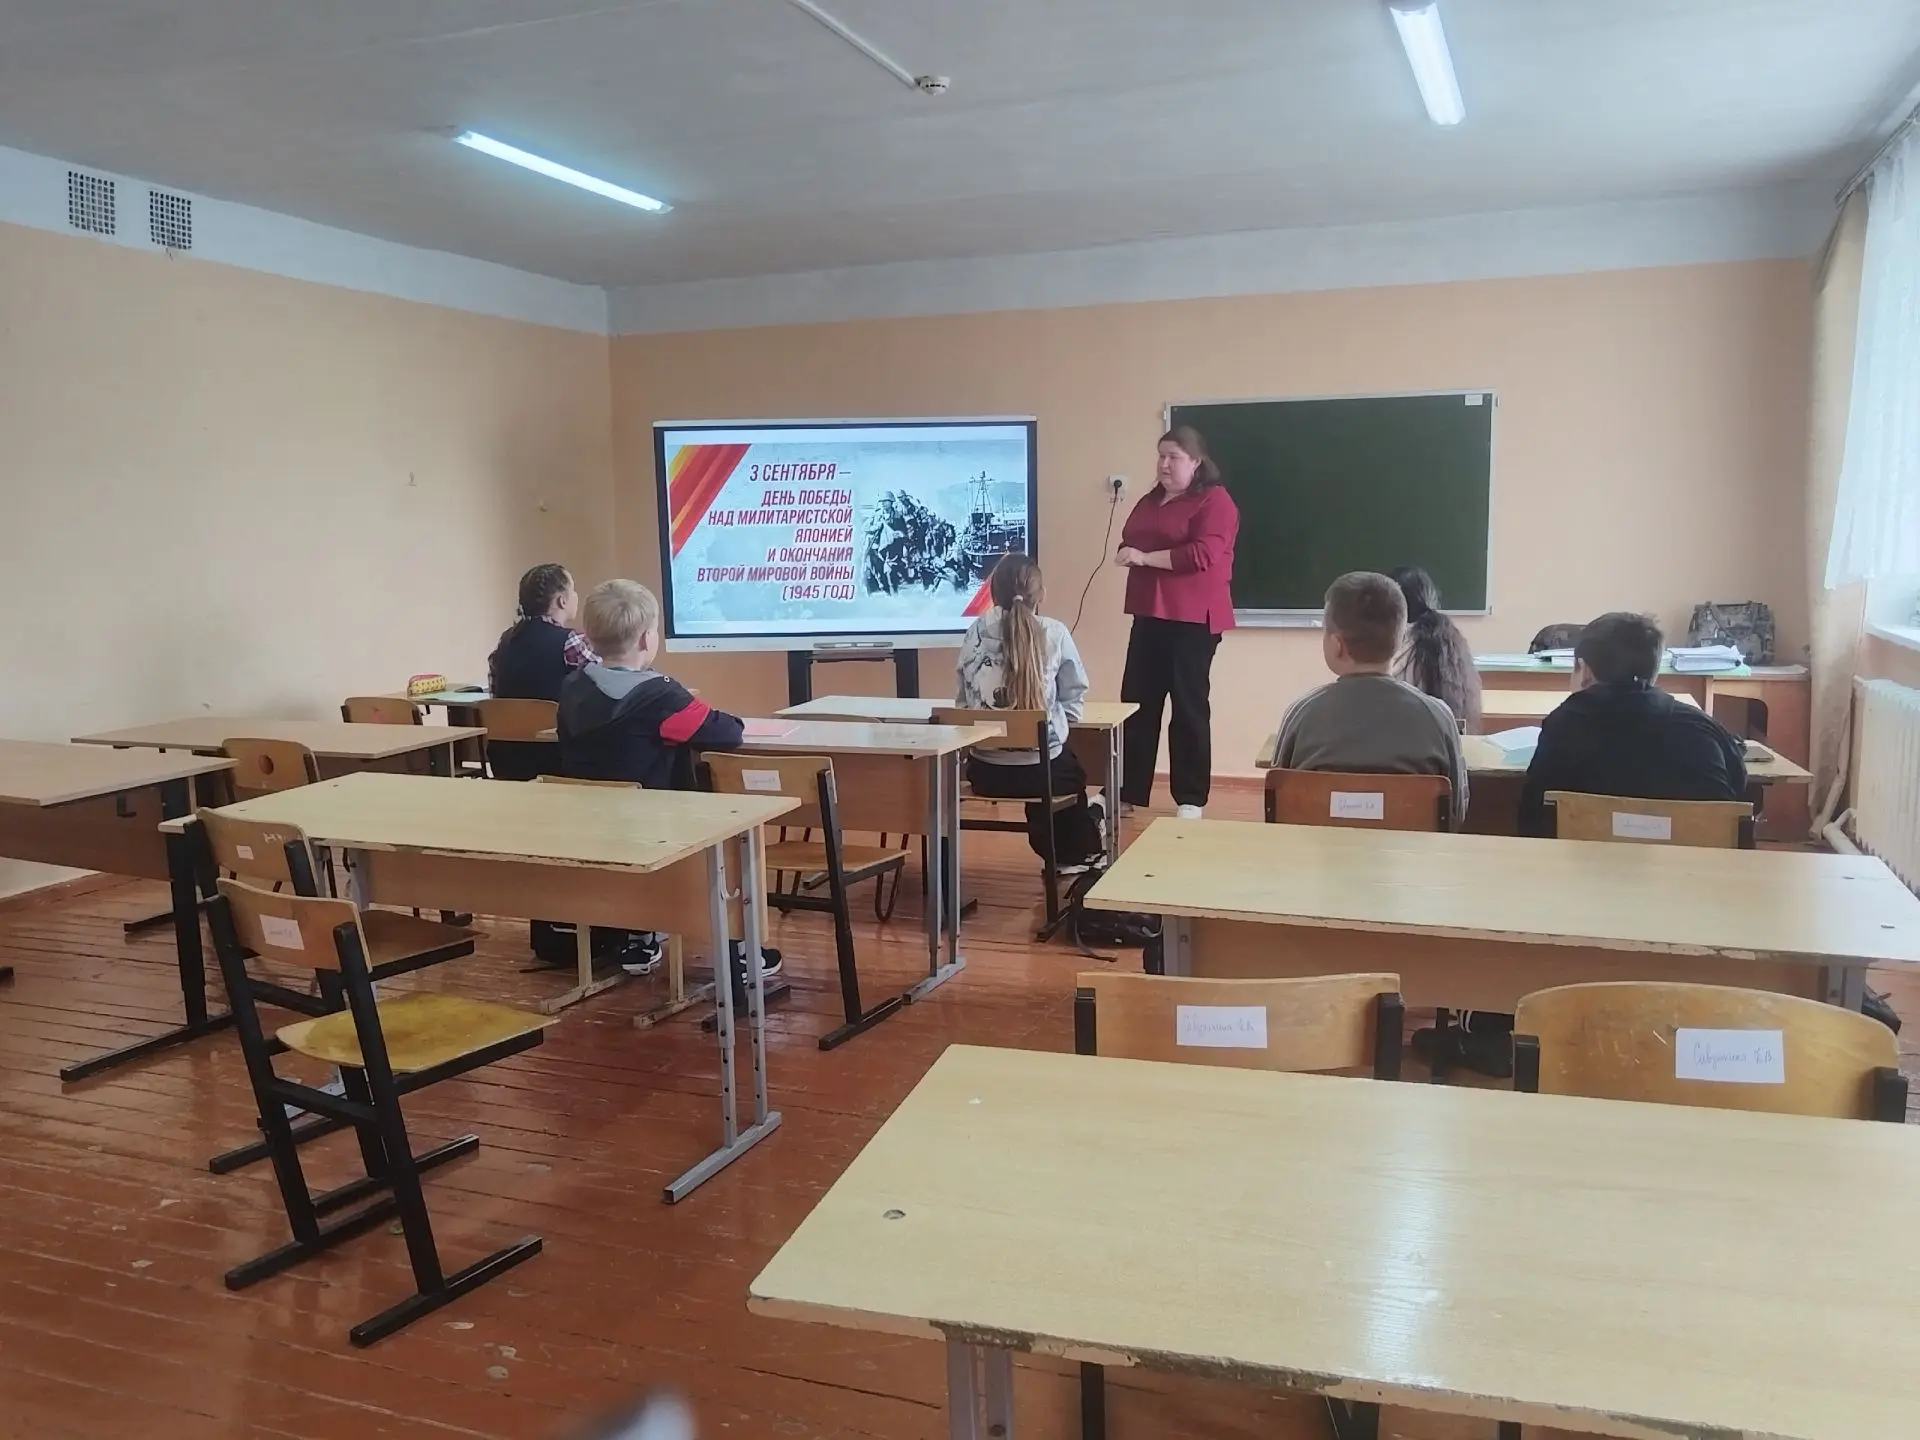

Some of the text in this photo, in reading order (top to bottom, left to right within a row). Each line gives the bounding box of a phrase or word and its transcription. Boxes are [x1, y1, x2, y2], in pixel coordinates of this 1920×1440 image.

[750, 464, 758, 481] 3
[762, 463, 836, 481] СЕНТЯБРЯ
[761, 489, 852, 507] ДЕНЬ ПОБЕДЫ
[708, 506, 853, 526] НАД МИЛИТАРИСТСКОЙ
[795, 525, 853, 543] ЯПОНИЕЙ
[767, 547, 853, 562] И ОКОНЧАНИЯ
[697, 563, 854, 582] ВТОРОЙ МИРОВОЙ ВОЙНЫ
[782, 584, 855, 601] (1945 ГОД)
